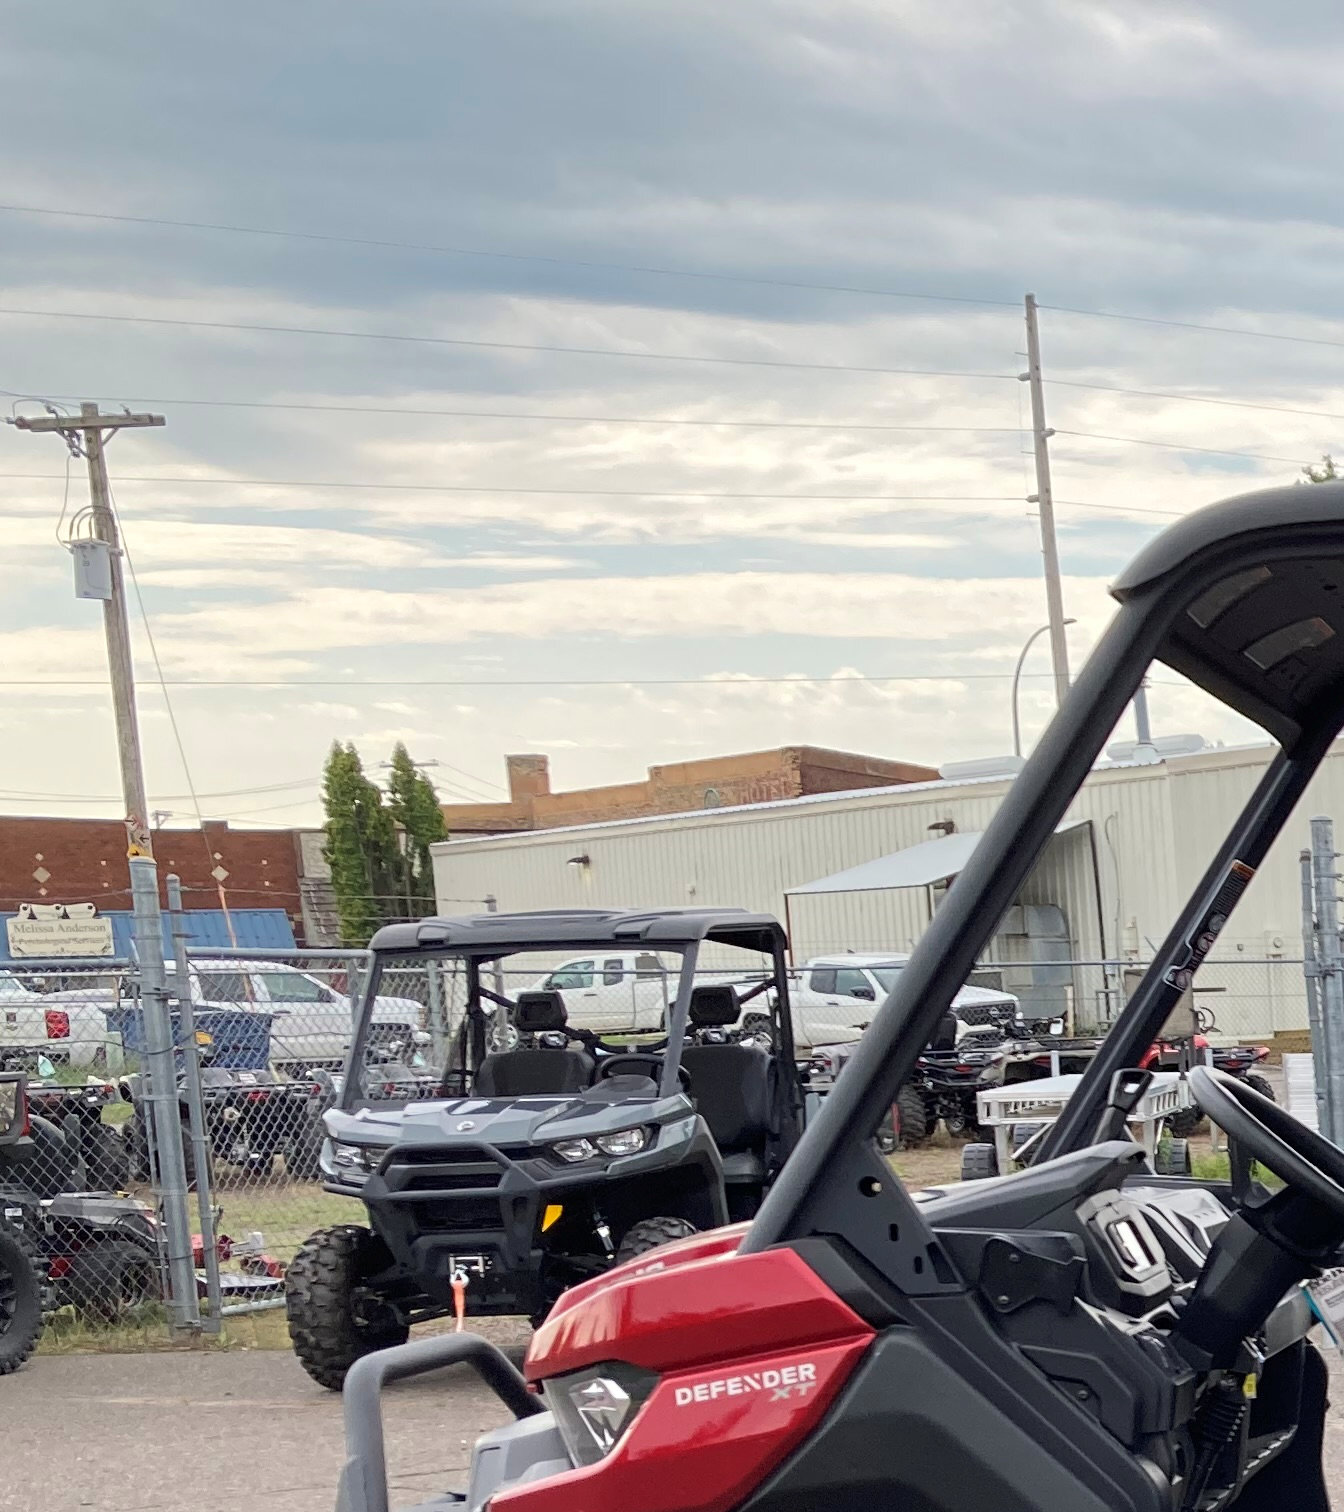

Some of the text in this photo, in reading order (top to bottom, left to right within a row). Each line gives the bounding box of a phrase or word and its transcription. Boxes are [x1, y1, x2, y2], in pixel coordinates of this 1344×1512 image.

[13, 923, 106, 934] Melissa Anderson
[675, 1363, 816, 1406] DEFENDER
[769, 1381, 816, 1402] XT
